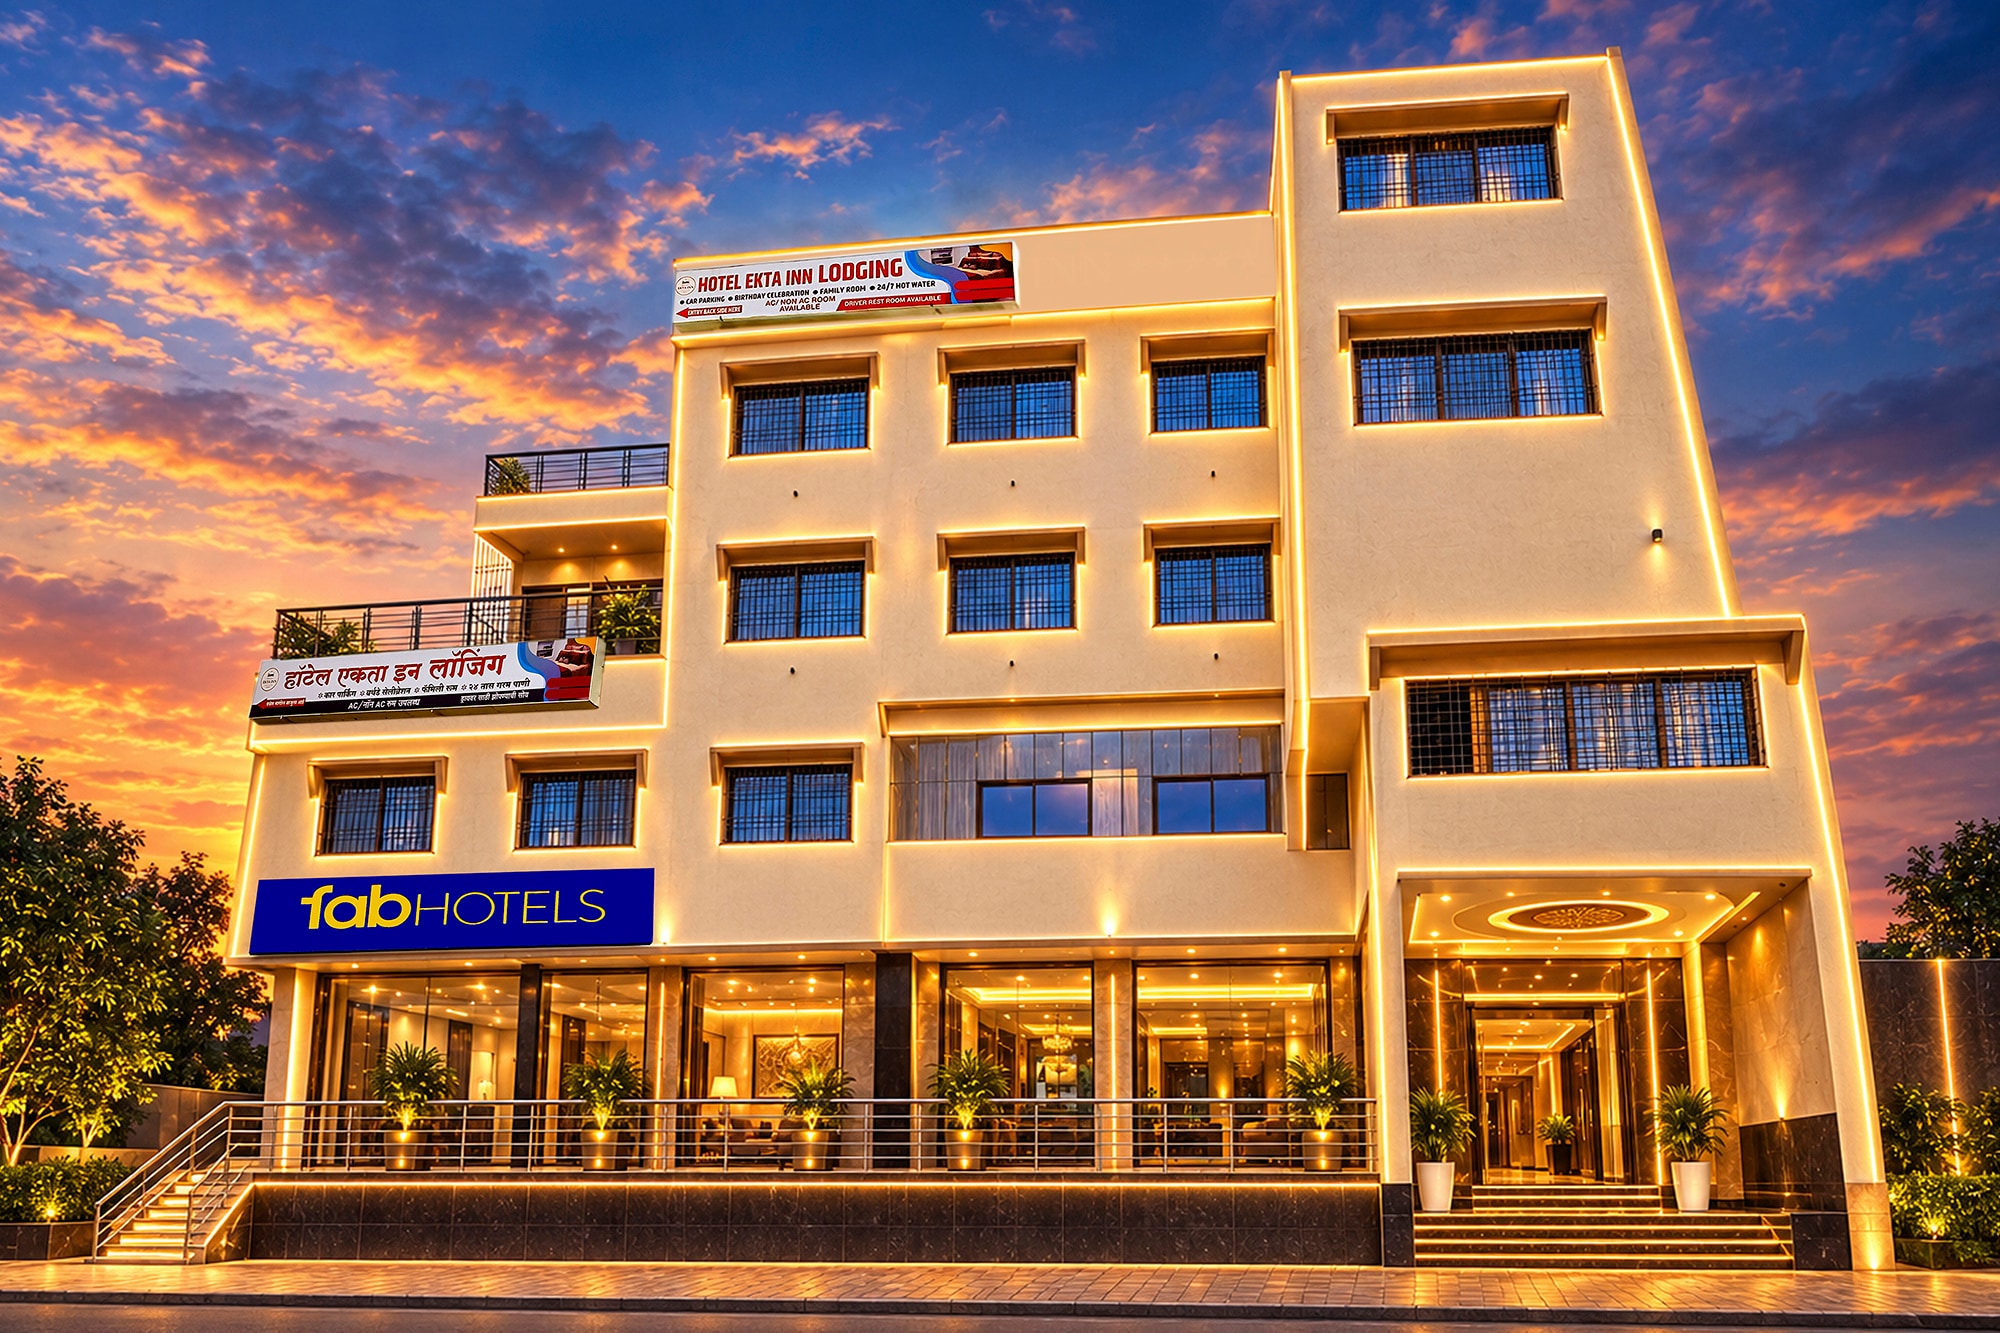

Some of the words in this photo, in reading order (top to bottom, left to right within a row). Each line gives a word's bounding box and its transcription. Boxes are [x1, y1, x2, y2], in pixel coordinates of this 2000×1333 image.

[698, 274, 741, 292] HOTEL
[745, 271, 782, 289] EKTA
[786, 268, 813, 286] INN
[818, 258, 902, 283] LODGING
[734, 293, 766, 301] BIRTHDAY
[767, 290, 810, 299] CELEBRATION
[820, 287, 845, 295] FAMILY
[846, 285, 866, 293] ROOM
[876, 283, 894, 291] 24/7
[896, 282, 910, 290] HOT
[912, 280, 936, 288] WATER
[779, 303, 820, 312] AVAILABLE
[284, 663, 334, 690] हॉटेल
[338, 665, 389, 688] एकता
[393, 663, 422, 684] इन
[429, 648, 506, 680] लॉजिंग
[496, 681, 512, 689] गरम
